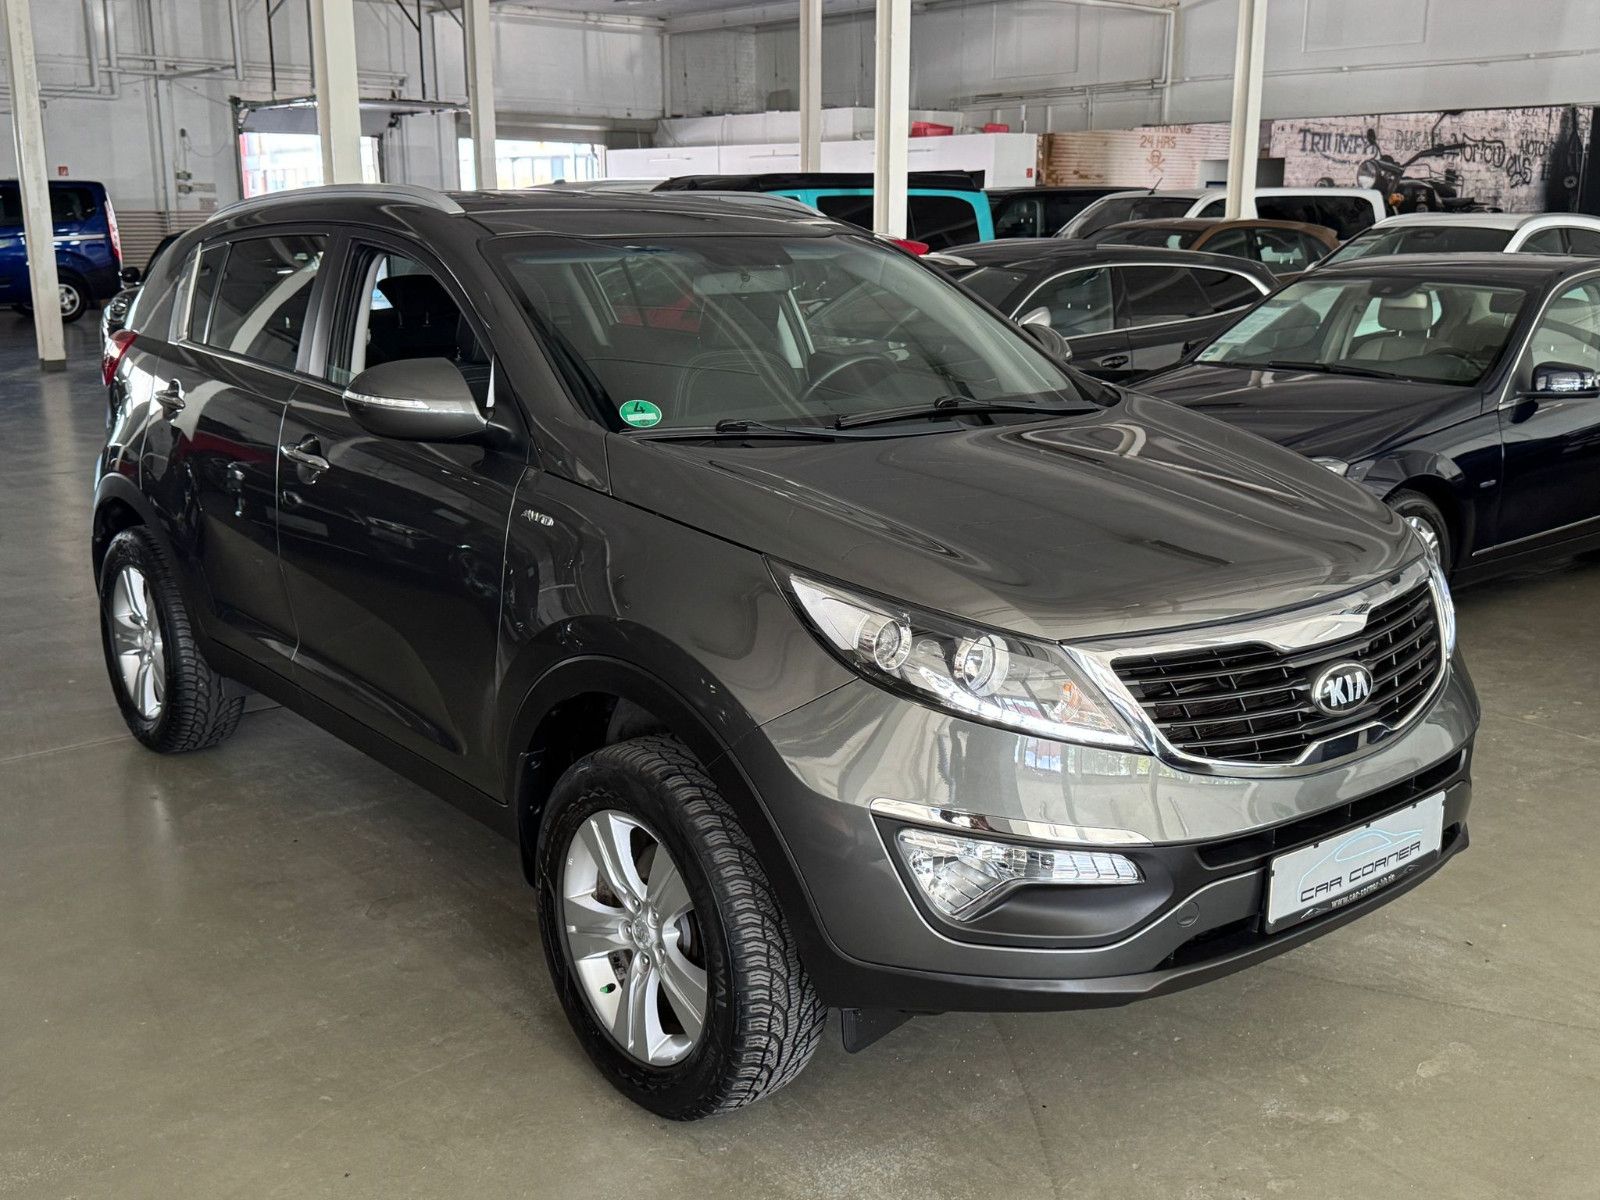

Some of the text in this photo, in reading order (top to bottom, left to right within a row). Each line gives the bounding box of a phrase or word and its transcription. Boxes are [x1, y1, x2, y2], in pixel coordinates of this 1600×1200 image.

[1140, 135, 1176, 149] 24 HRS
[633, 401, 645, 414] 4
[521, 509, 554, 526] AWD
[1326, 670, 1369, 707] KIA
[1300, 841, 1421, 902] CAR CORNER
